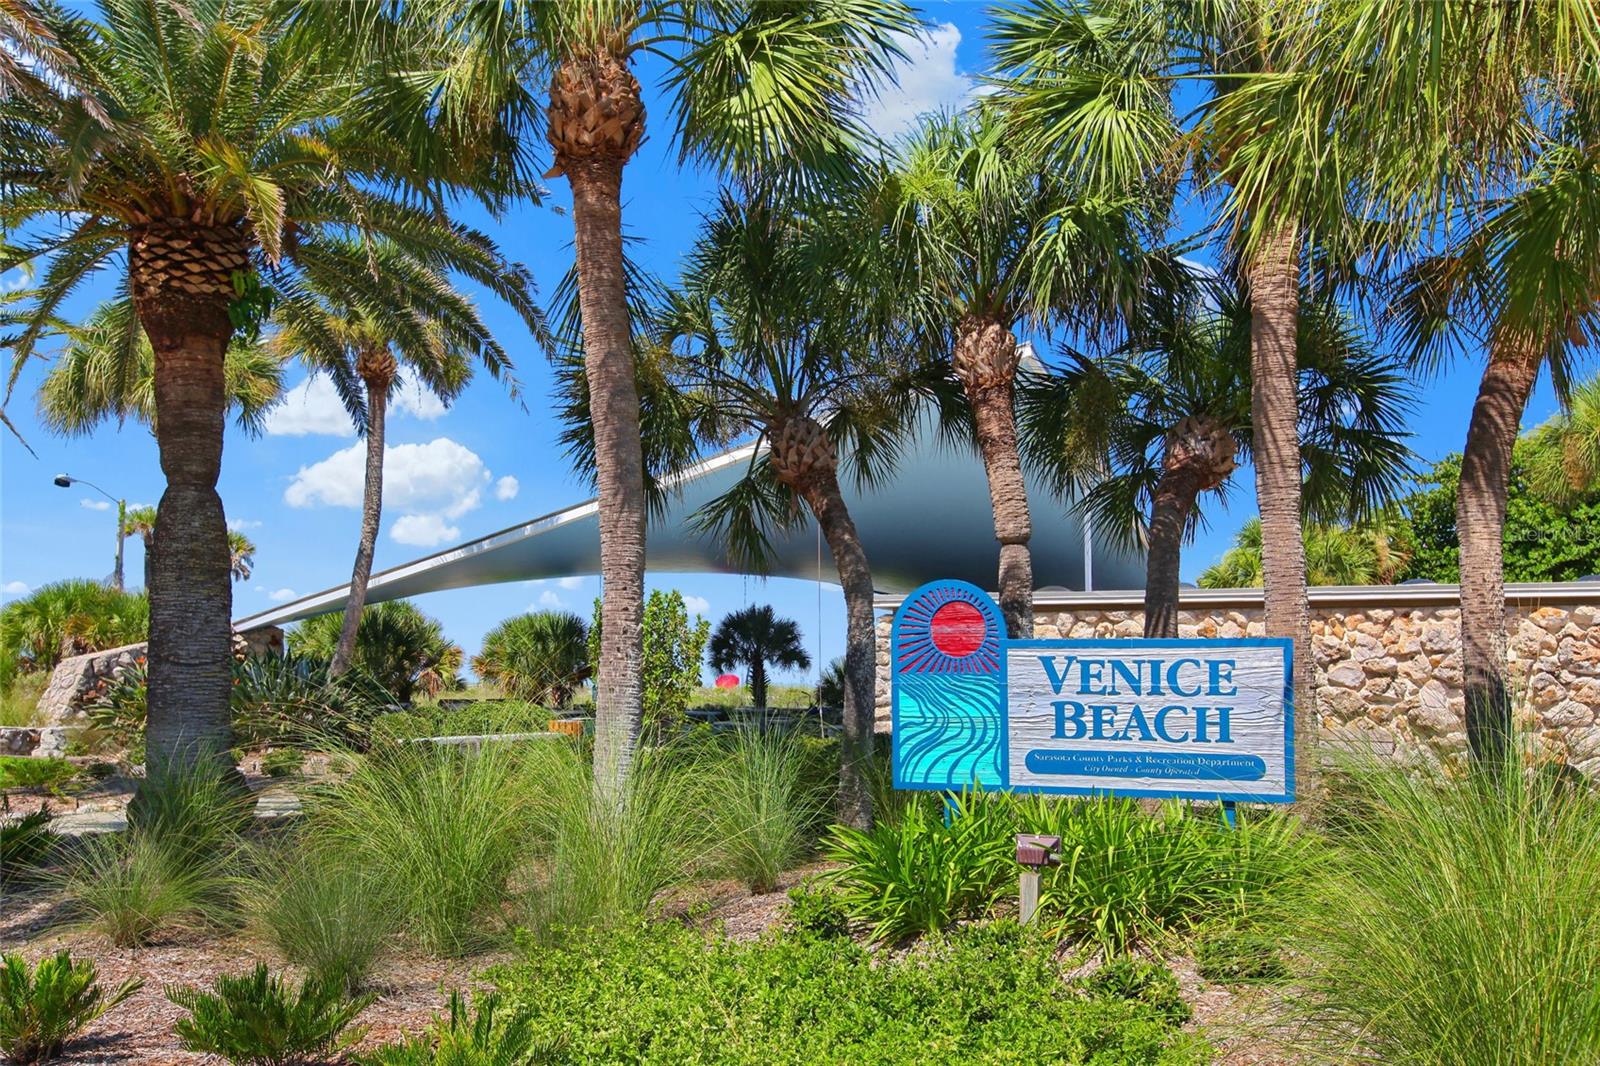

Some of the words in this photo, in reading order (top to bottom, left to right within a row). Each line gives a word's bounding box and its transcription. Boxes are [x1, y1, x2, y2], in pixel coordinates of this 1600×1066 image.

[1037, 656, 1237, 697] VENICE
[1050, 701, 1234, 743] BEACH
[1034, 753, 1071, 761] Sarasota
[1072, 754, 1104, 763] County
[1107, 755, 1132, 763] Parks
[1135, 756, 1142, 764] &
[1145, 756, 1194, 765] Recreation
[1198, 757, 1255, 768] Department
[1084, 765, 1100, 773] City
[1101, 765, 1129, 773] Owned
[1135, 766, 1162, 774] County
[1164, 767, 1200, 776] Operated
